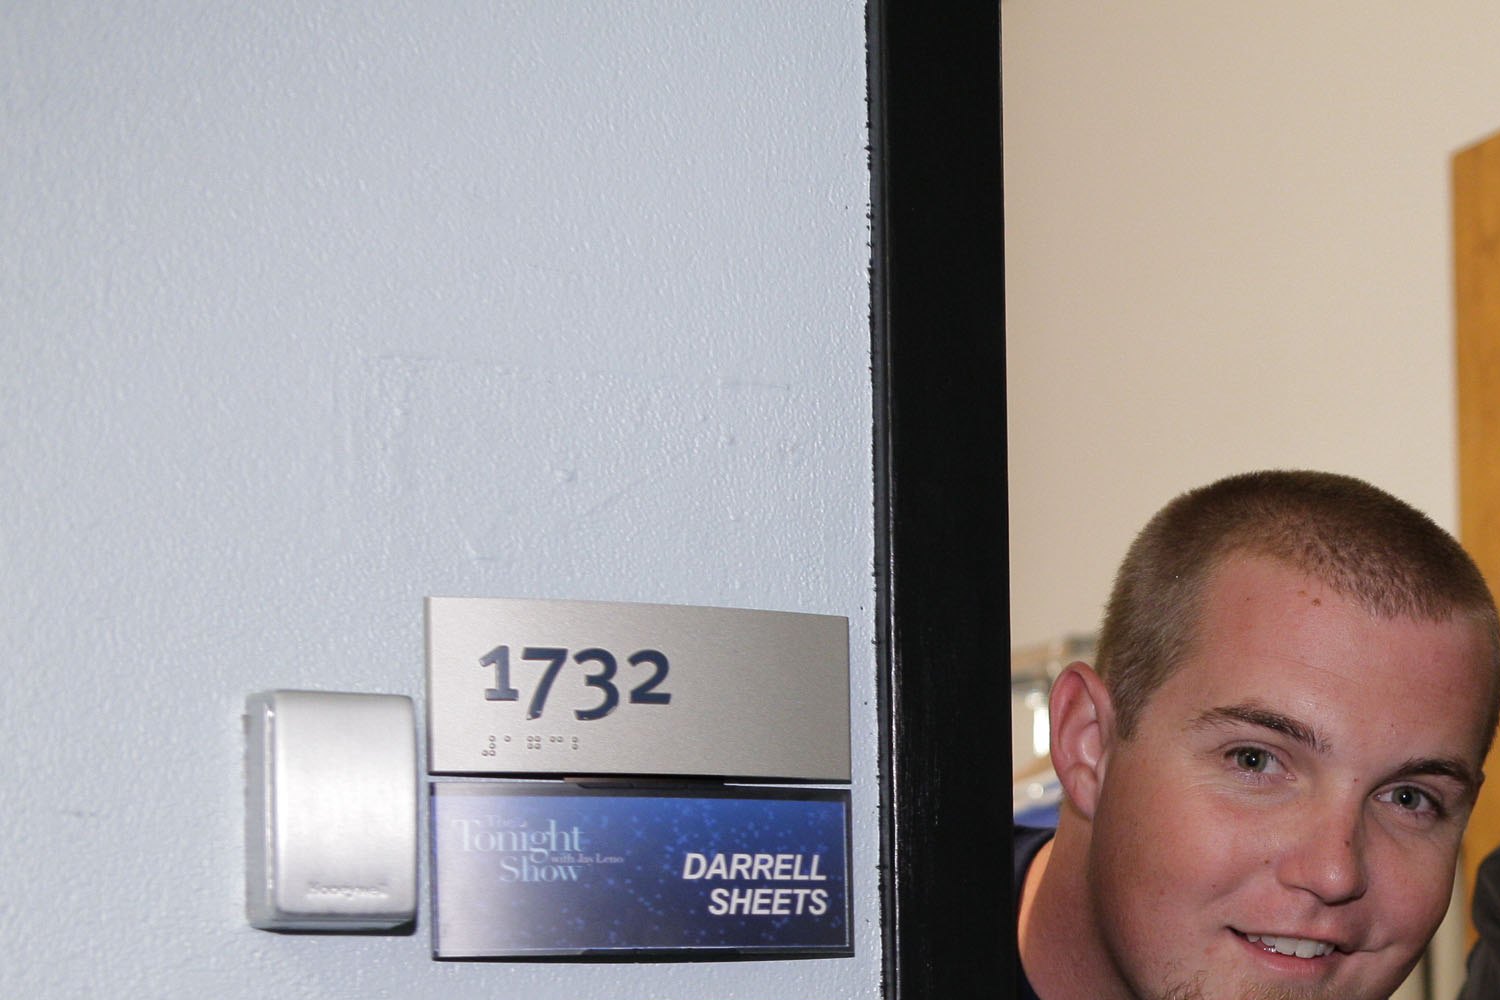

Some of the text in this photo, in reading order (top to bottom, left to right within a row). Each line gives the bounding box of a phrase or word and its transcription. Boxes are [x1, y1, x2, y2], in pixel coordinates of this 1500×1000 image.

[479, 645, 672, 721] 1732
[451, 819, 584, 864] Tonight
[500, 855, 584, 882] Show
[682, 853, 827, 881] DARRELL
[708, 888, 829, 915] SHEETS
